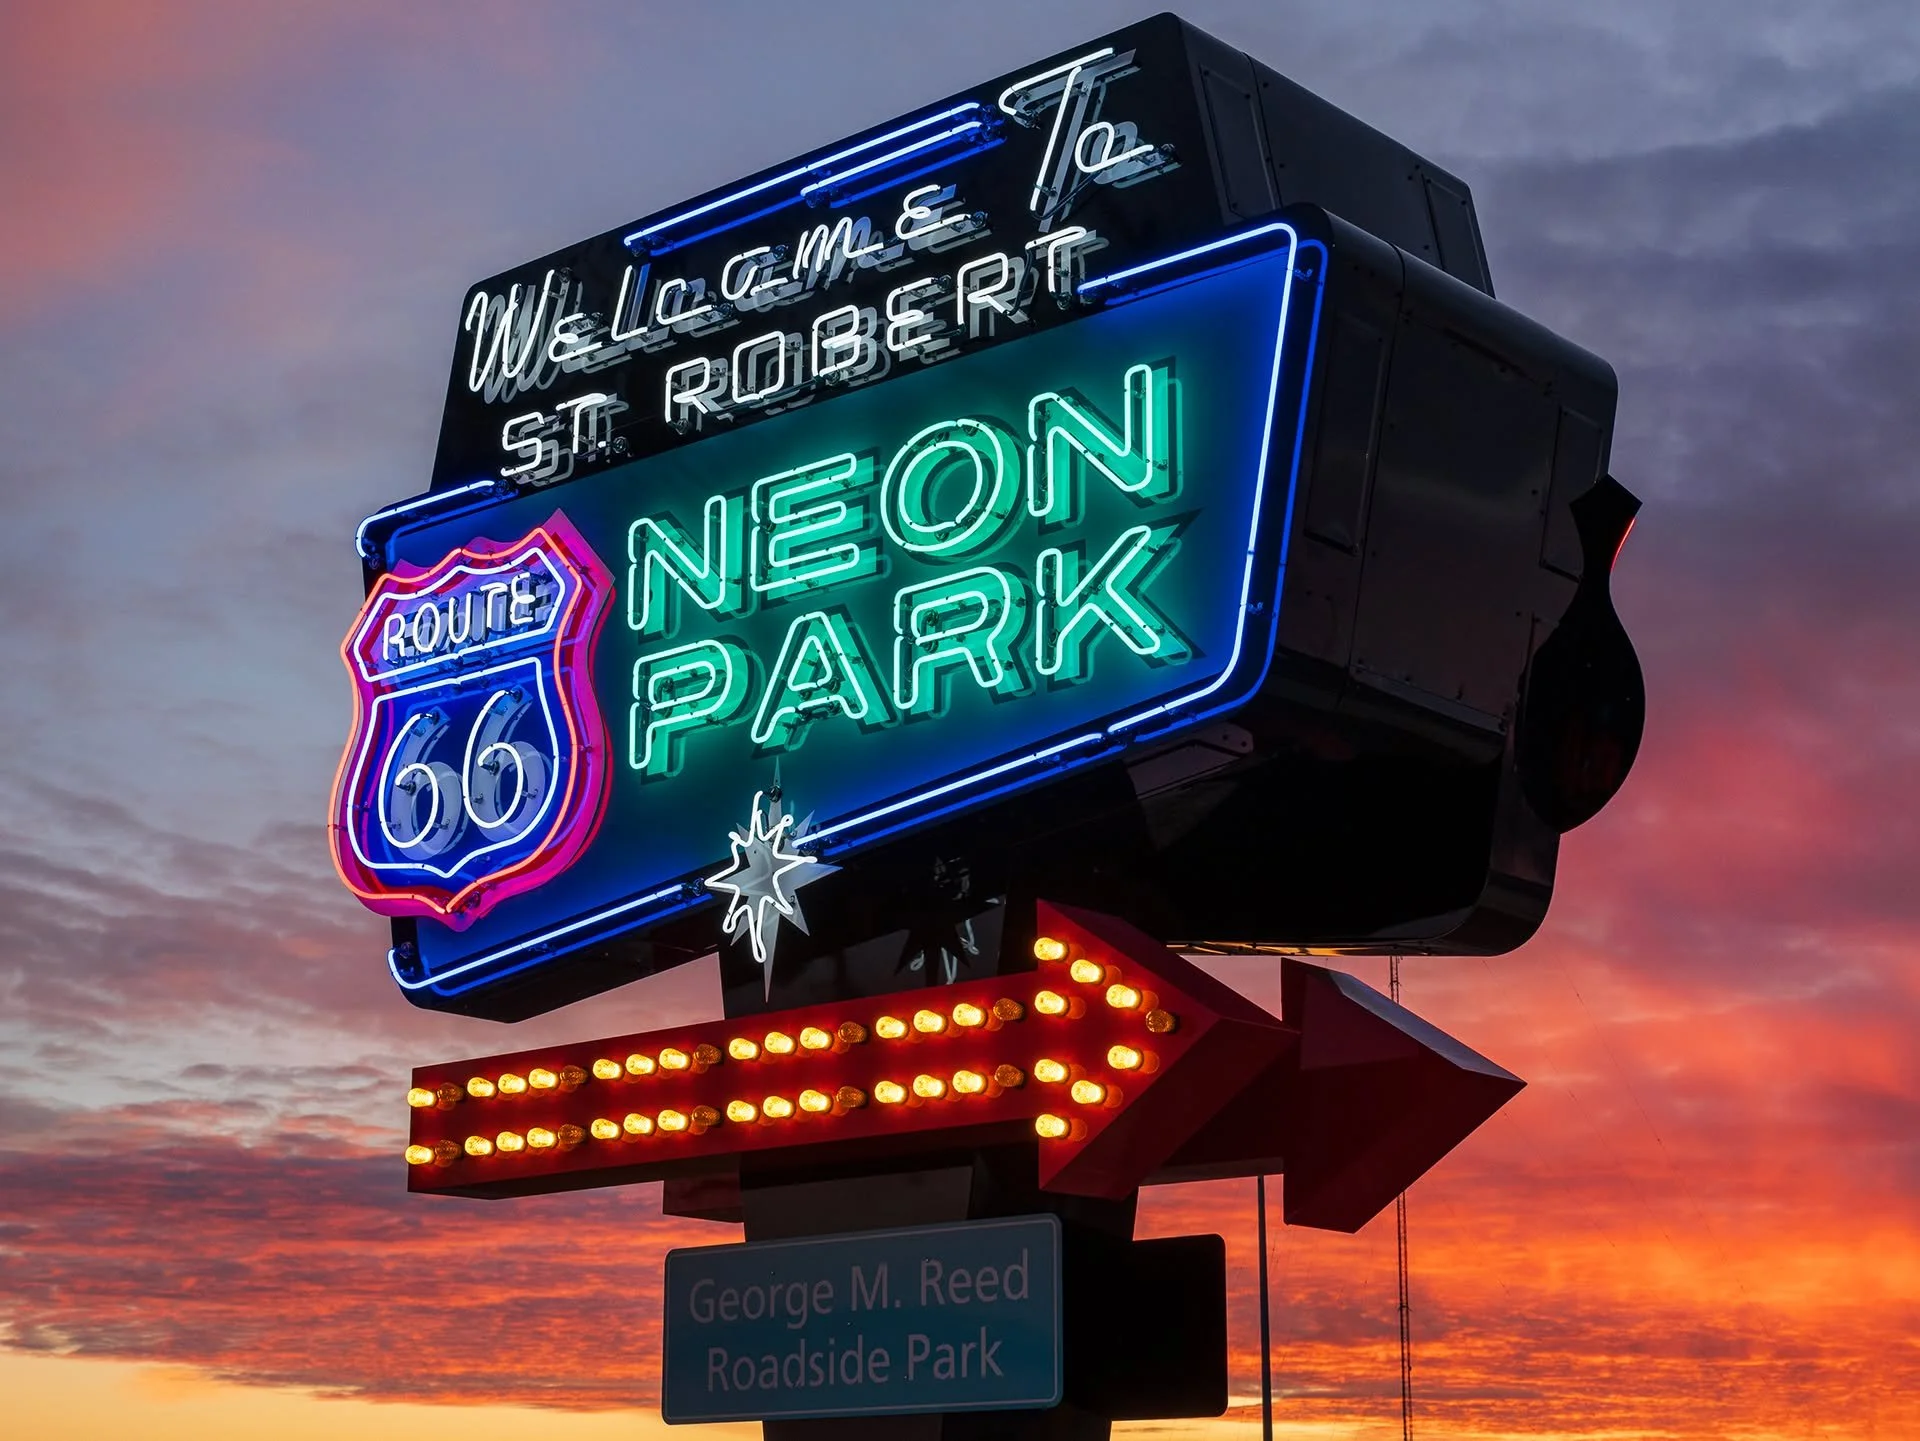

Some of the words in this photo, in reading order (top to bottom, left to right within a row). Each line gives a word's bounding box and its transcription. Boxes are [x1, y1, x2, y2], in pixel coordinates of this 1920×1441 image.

[664, 226, 1088, 425] ROBERT
[627, 364, 1153, 631] NEON
[382, 572, 536, 662] ROUTE
[627, 525, 1160, 770] PARK
[378, 690, 524, 848] 66
[689, 1278, 834, 1329] George
[851, 1261, 901, 1311] M.
[920, 1247, 1029, 1306] Reed
[707, 1335, 890, 1392] Roadside
[907, 1326, 1004, 1381] Park
